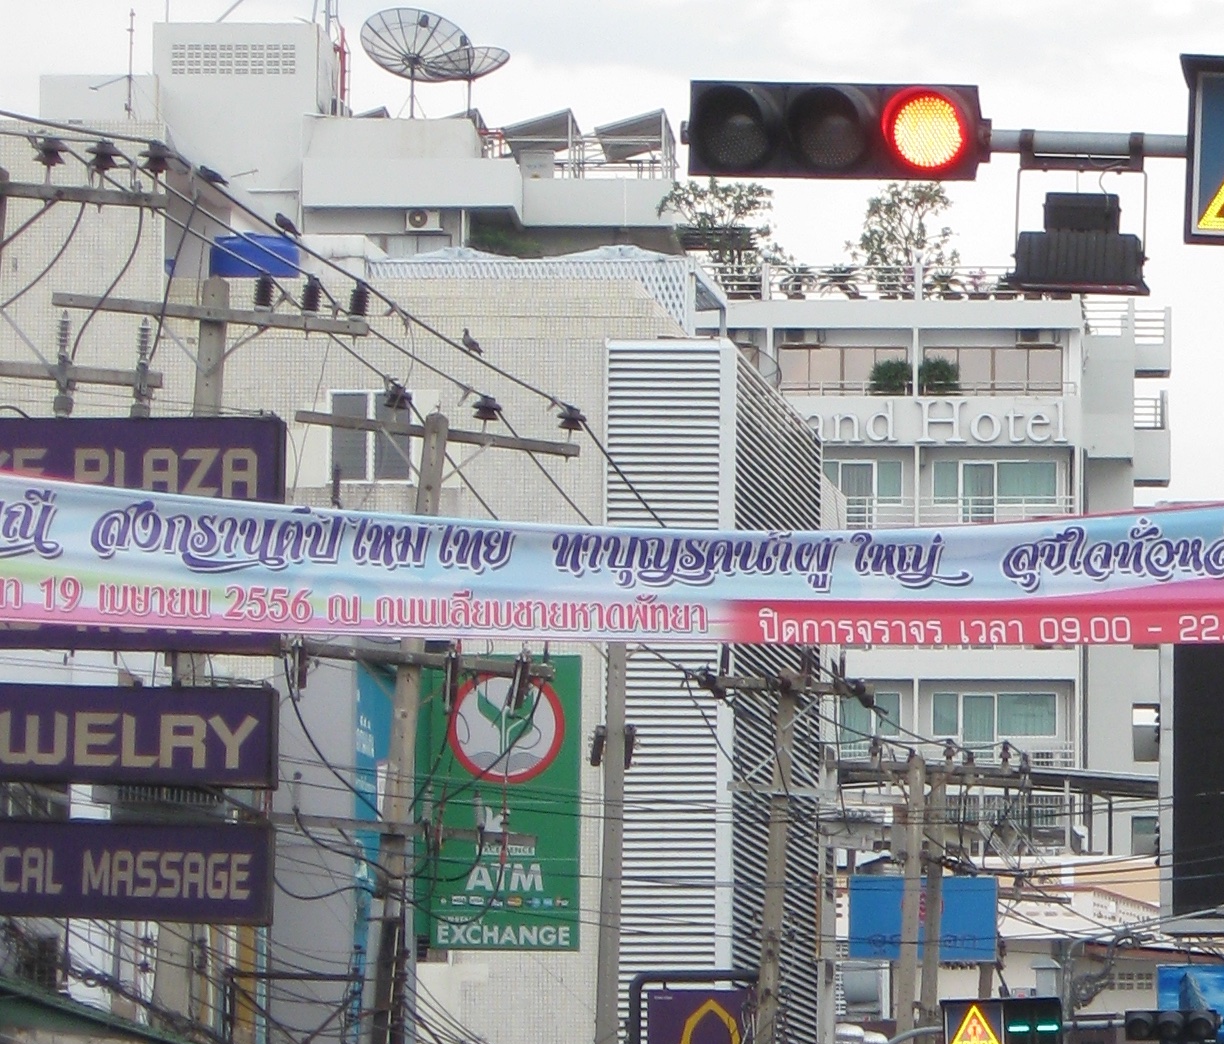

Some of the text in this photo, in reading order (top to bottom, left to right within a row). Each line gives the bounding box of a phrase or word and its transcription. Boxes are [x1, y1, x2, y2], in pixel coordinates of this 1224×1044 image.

[915, 400, 1068, 443] Hotel
[40, 576, 82, 613] 19
[100, 582, 211, 620] เมษายน
[224, 583, 313, 624] 2556
[327, 590, 360, 627] ณ
[374, 588, 709, 633] ถนนเลียบชายหาดพัทยา
[758, 606, 943, 644] ปิดการจราจร
[959, 618, 1024, 645] เวลา
[1039, 614, 1131, 643] 09.00
[0, 711, 260, 770] WELRY
[82, 849, 253, 900] MASSAGE
[465, 863, 544, 891] ATM
[437, 925, 571, 946] EXCHANGE
